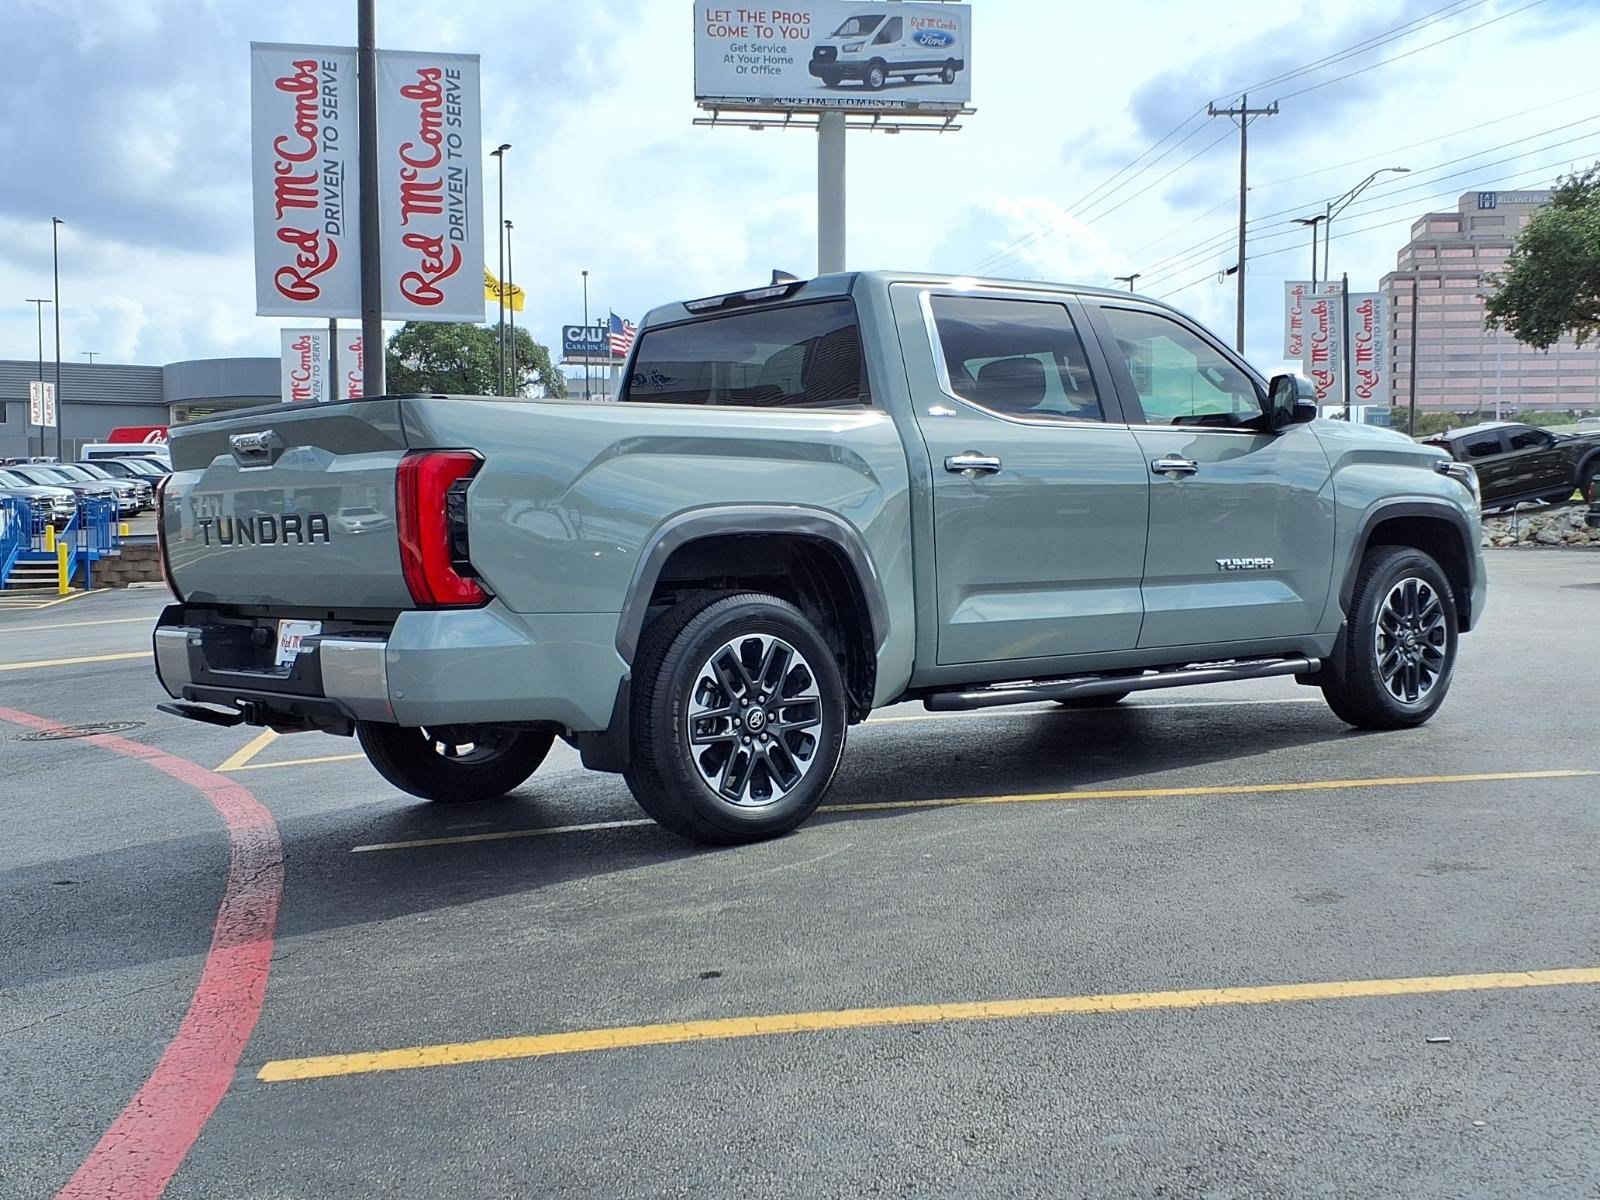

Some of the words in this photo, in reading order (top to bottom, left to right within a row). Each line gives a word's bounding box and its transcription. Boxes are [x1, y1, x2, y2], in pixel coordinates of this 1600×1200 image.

[706, 8, 732, 22] LET
[737, 9, 766, 23] THE
[772, 10, 811, 24] PROS
[706, 24, 748, 38] COME
[753, 25, 774, 39] TO
[779, 26, 810, 39] YOU
[920, 32, 949, 46] Ford
[723, 54, 734, 63] At
[737, 54, 760, 64] Your
[763, 55, 794, 65] Home
[730, 43, 748, 53] Get
[750, 43, 787, 54] Service
[736, 65, 747, 74] Or
[751, 65, 782, 75] Office
[321, 60, 338, 121] SERVE
[445, 68, 462, 128] SERVE
[273, 59, 320, 221] McCombs
[322, 126, 339, 153] TO
[399, 67, 444, 227] McCombs
[446, 133, 463, 160] TO
[323, 159, 342, 236] DRIVEN
[448, 166, 465, 241] DRIVEN
[273, 227, 339, 302] Red
[400, 233, 463, 306] Red
[1289, 333, 1303, 355] Red
[1311, 299, 1329, 367] McCombs
[1329, 327, 1336, 338] TO
[1355, 299, 1373, 367] McCombs
[1373, 327, 1381, 338] TO
[312, 335, 320, 362] SERVE
[1329, 341, 1337, 372] DRIVEN
[1374, 341, 1382, 372] DRIVEN
[312, 364, 320, 377] TO
[1355, 369, 1380, 399] Red
[199, 512, 331, 547] TUNDRA
[1216, 557, 1274, 571] TUNDRA
